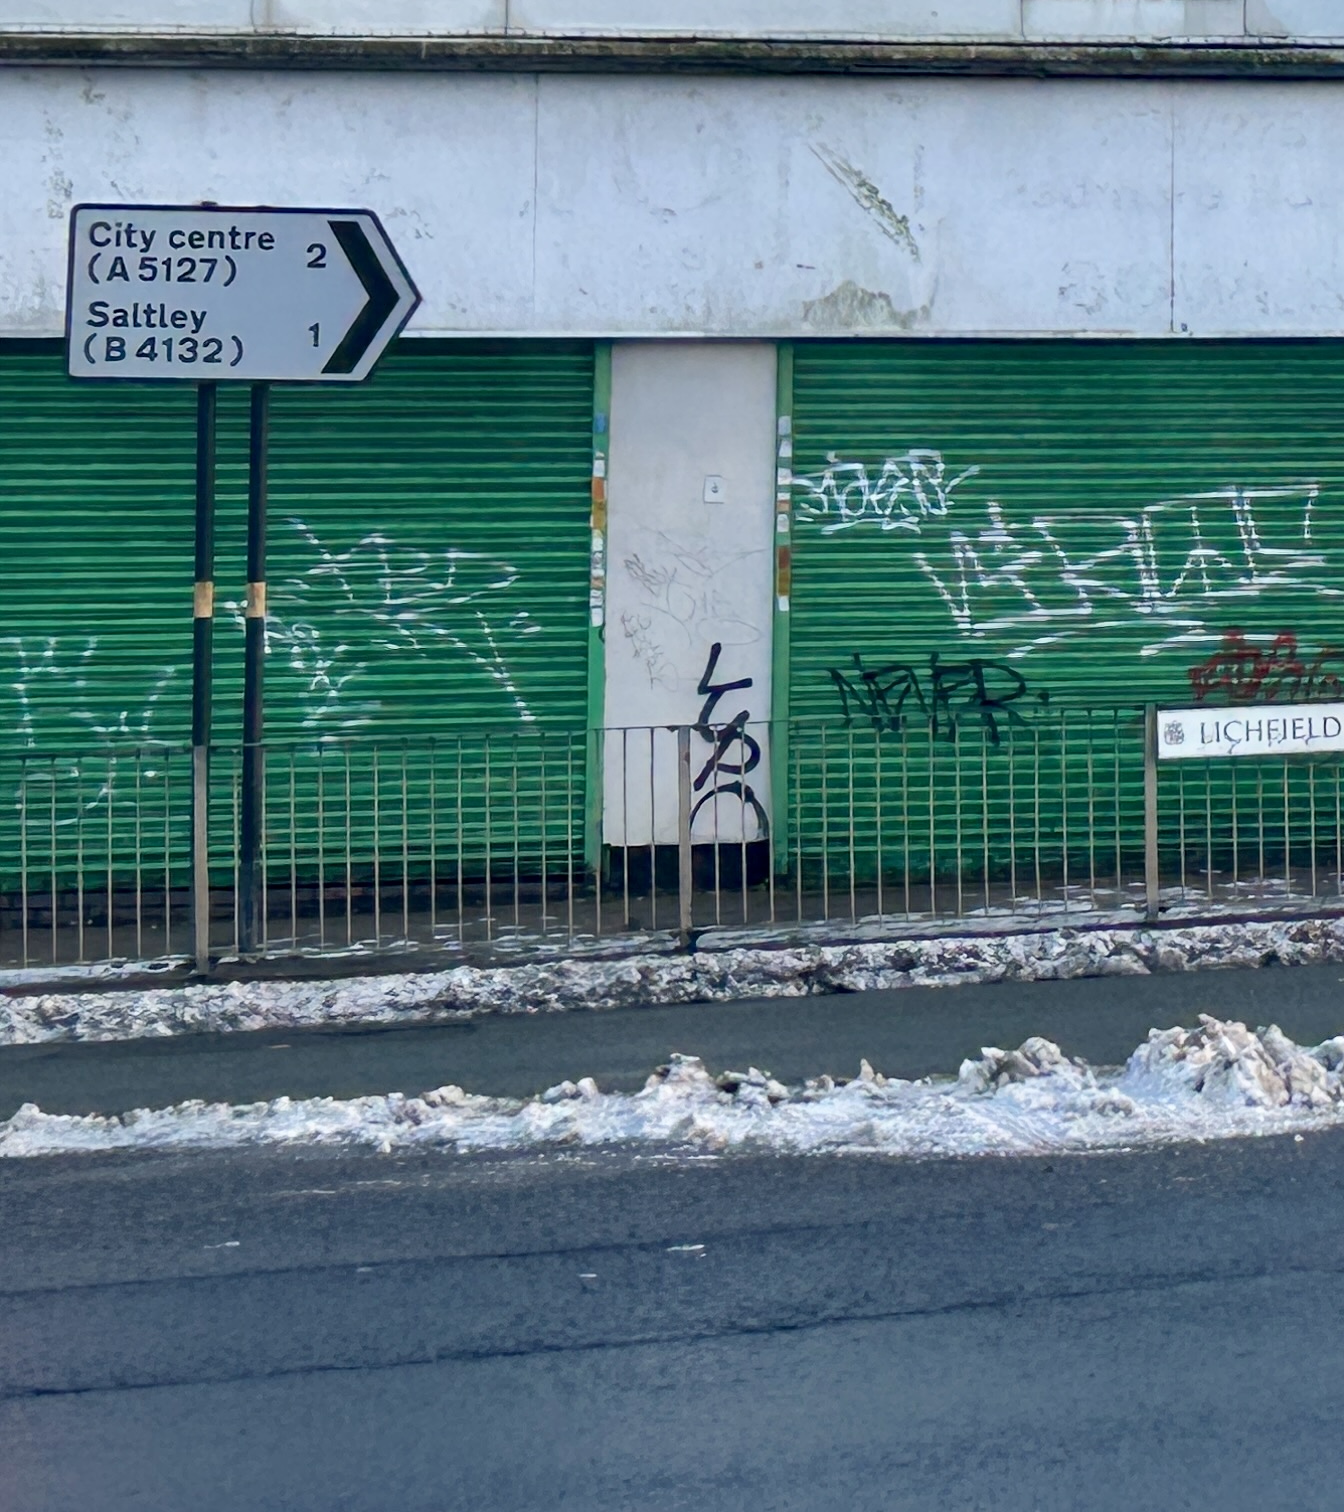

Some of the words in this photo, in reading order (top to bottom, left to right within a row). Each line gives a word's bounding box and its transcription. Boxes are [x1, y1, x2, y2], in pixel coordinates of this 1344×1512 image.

[89, 221, 157, 253] City
[168, 226, 275, 251] centre
[306, 243, 328, 269] 2
[86, 300, 208, 334] Saltley
[308, 322, 321, 348] 1
[1200, 715, 1342, 745] LICHFIELD
